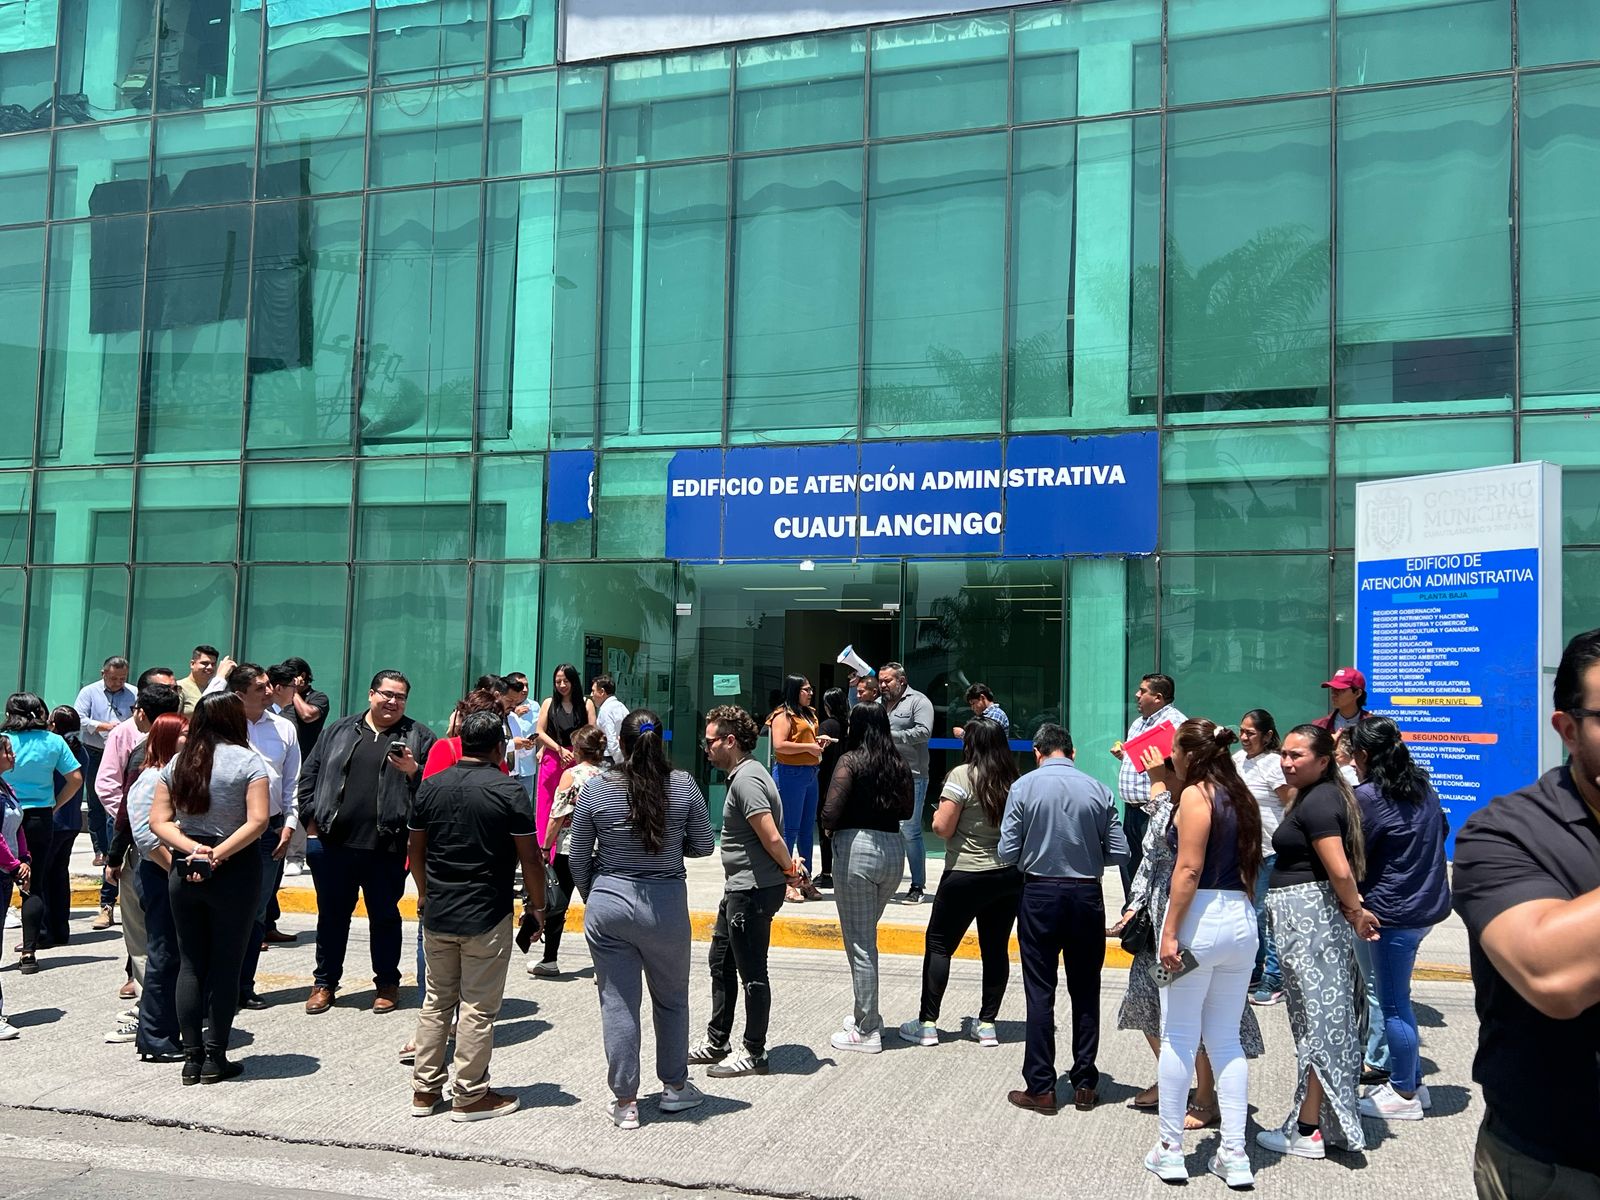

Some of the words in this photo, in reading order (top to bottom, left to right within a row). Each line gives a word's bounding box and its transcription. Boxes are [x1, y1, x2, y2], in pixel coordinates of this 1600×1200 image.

[672, 477, 764, 497] EDIFICIO
[769, 476, 799, 495] DE
[803, 464, 915, 494] ATENCIÓN
[921, 464, 1127, 491] ADMINISTRATIVA
[773, 511, 1003, 539] CUAUTLANCINGO
[1406, 555, 1461, 572] EDIFICIO
[1463, 554, 1482, 568] DE
[1361, 573, 1422, 591] ATENCIÓN
[1425, 568, 1534, 587] ADMINISTRATIVA
[1443, 780, 1480, 788] ECONÓMICO
